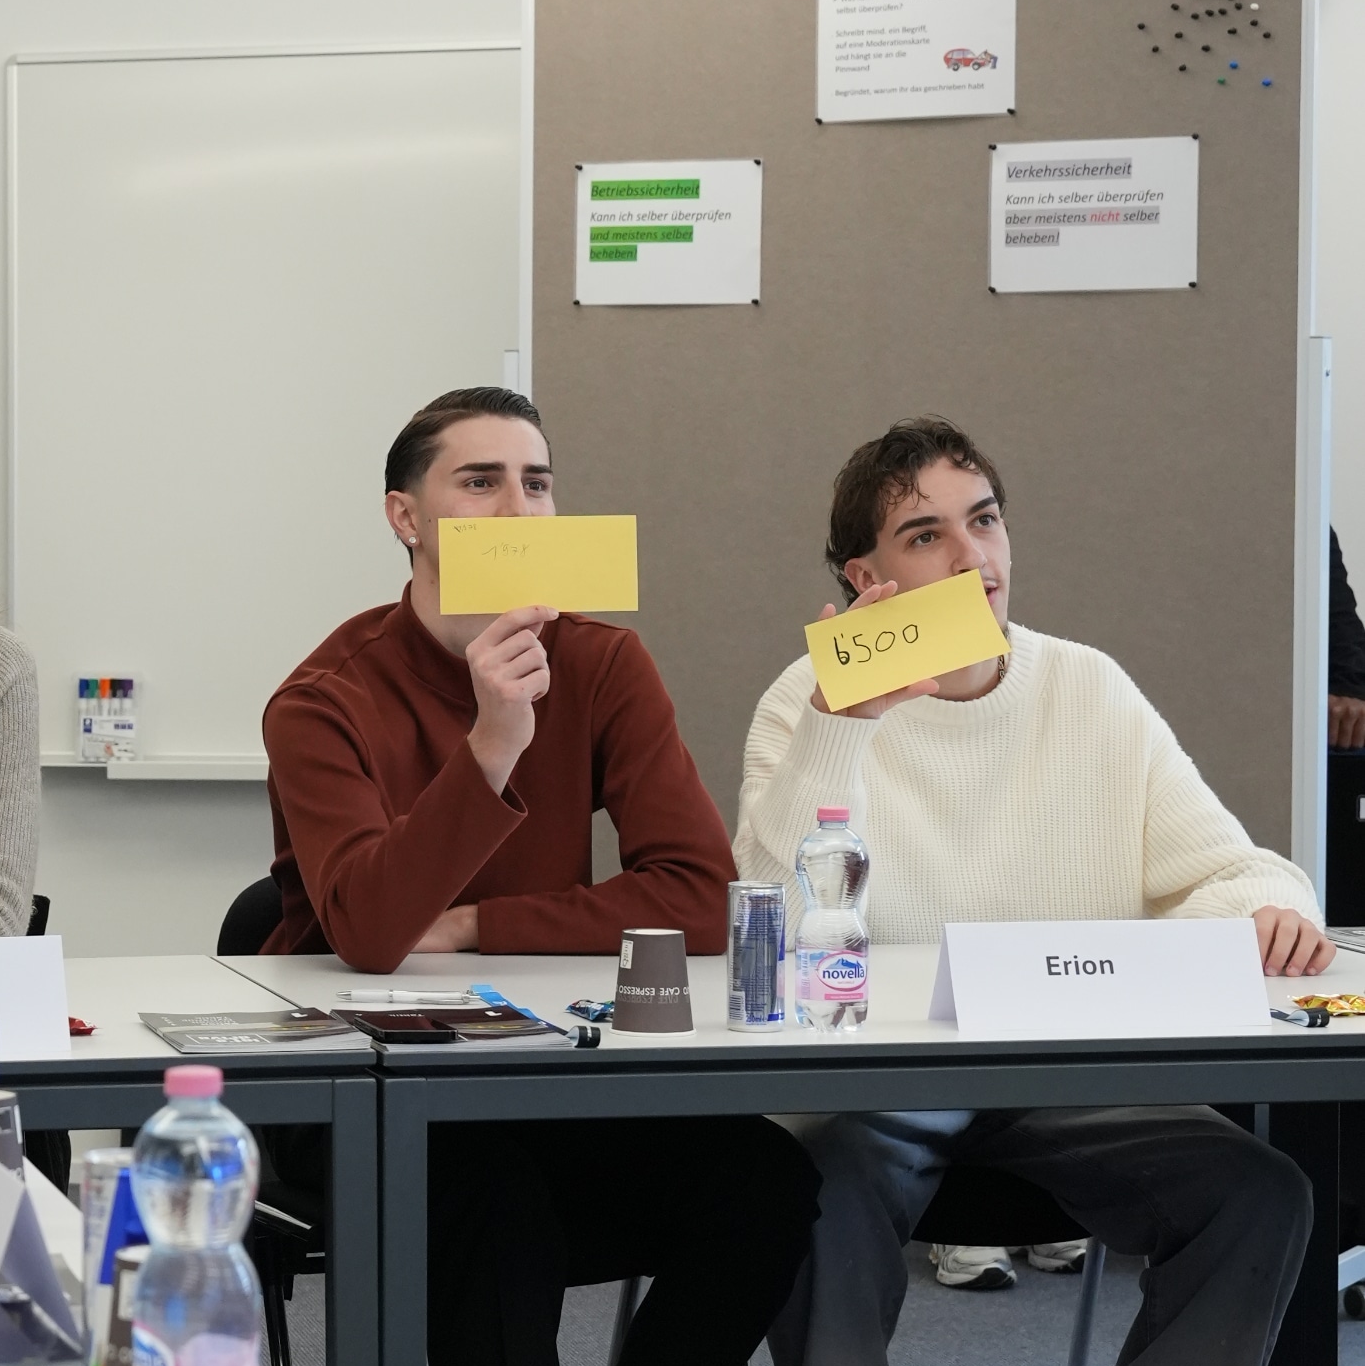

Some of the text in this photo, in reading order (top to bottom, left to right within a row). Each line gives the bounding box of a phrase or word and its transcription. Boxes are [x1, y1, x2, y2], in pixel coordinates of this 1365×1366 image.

[836, 3, 903, 14] selbst überprüfen?
[836, 28, 864, 38] Schreibt
[836, 37, 930, 49] auf eine Moderationskarte
[836, 53, 848, 61] und
[851, 52, 871, 60] hängt
[896, 50, 906, 58] die
[835, 64, 870, 73] Pinnwand
[899, 85, 908, 93] ihr
[924, 83, 965, 93] geschrieben
[1008, 163, 1132, 178] Verkehrssicherheit
[591, 184, 699, 197] Betriebssicherheit
[1005, 189, 1164, 205] Kann ich selber überprüfen
[590, 209, 731, 223] Kann ich selber überprüfen
[1005, 210, 1159, 224] aber meistens nicht selber
[590, 227, 693, 240] und meistens selber
[1005, 232, 1059, 244] beheben!
[590, 246, 637, 259] beheben!
[1046, 954, 1114, 976] Erion
[822, 964, 865, 979] novella
[618, 985, 656, 996] ESPRESSO
[659, 986, 680, 996] CAFE
